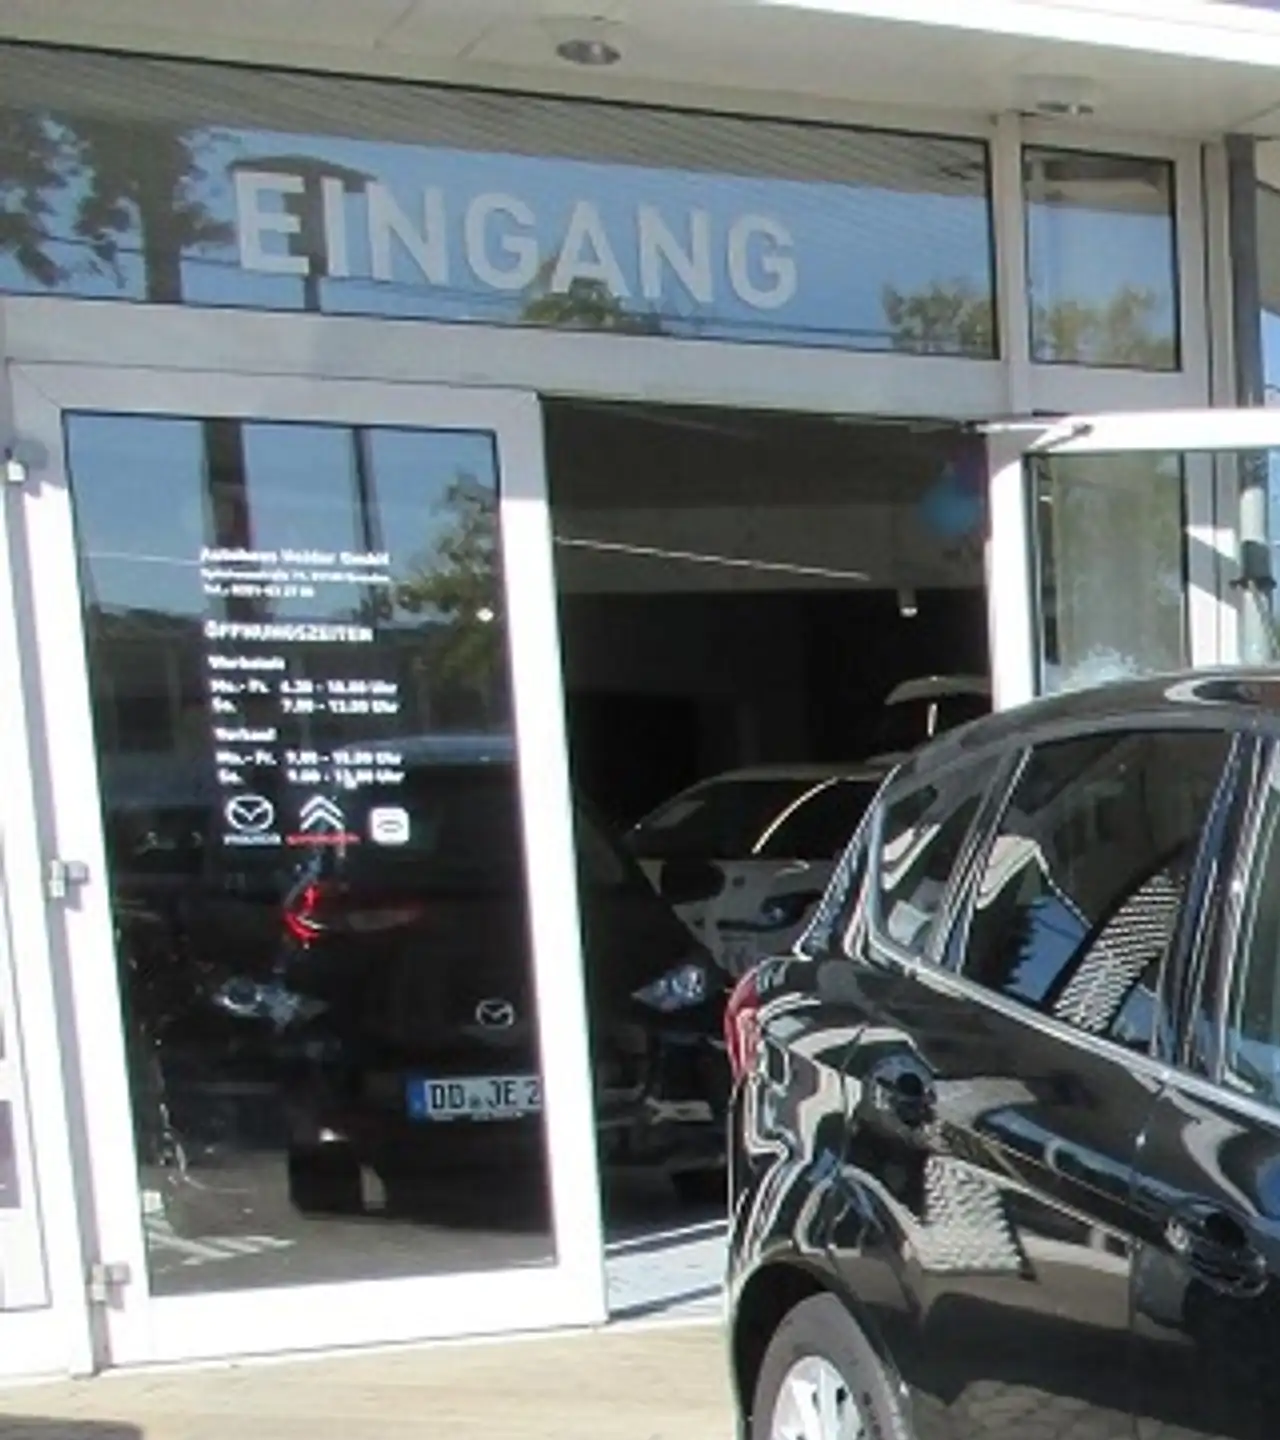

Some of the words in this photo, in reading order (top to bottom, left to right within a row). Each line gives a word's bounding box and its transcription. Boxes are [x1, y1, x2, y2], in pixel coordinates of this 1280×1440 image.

[234, 170, 799, 309] EINGANG
[430, 1084, 465, 1109] DD
[488, 1080, 517, 1107] JE
